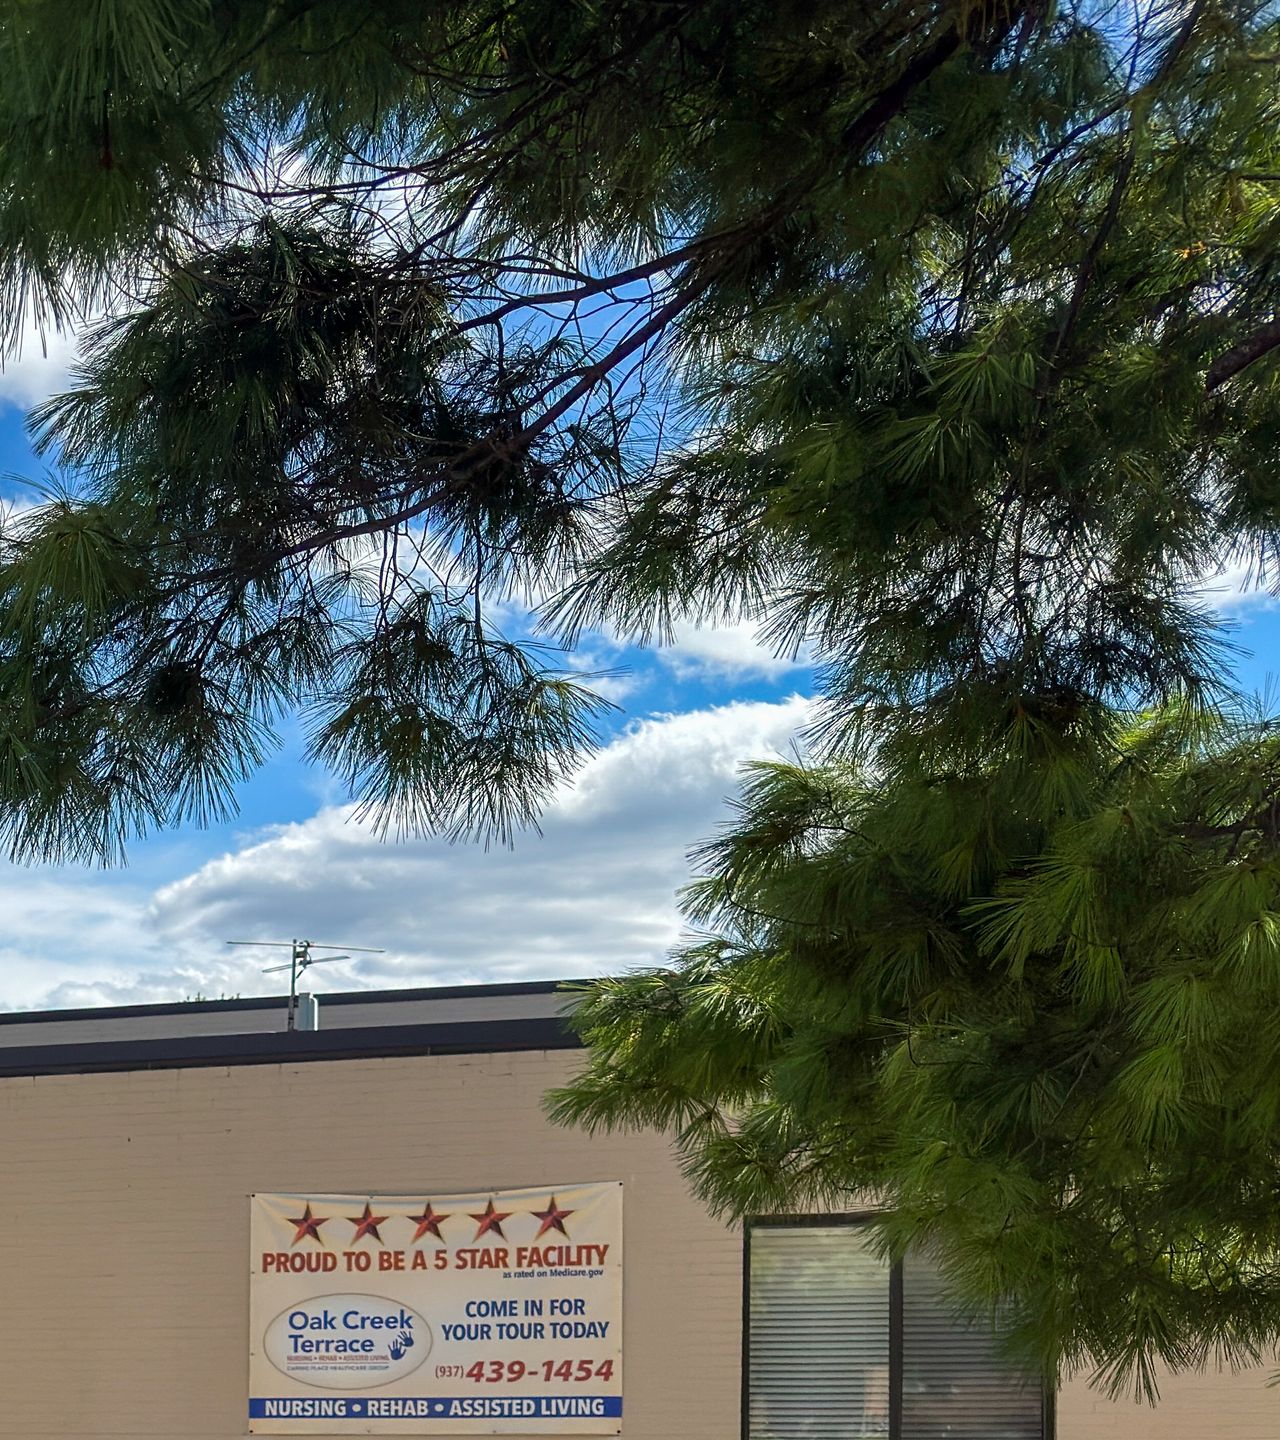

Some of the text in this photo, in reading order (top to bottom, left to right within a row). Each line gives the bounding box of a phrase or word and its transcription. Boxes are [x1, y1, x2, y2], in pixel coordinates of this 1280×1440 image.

[262, 1244, 610, 1273] PROUD TO BE A 5 STAR FACILITY
[514, 1270, 534, 1278] rated
[550, 1269, 603, 1278] Medicare.gov
[465, 1299, 586, 1318] COME IN FOR
[288, 1309, 413, 1331] Oak Creek
[442, 1321, 609, 1340] YOUR TOUR TODAY
[288, 1335, 374, 1353] Terrace
[435, 1360, 613, 1383] (937) 439-1454
[265, 1398, 605, 1417] NURSING REHAB ASSISTED LIVING
